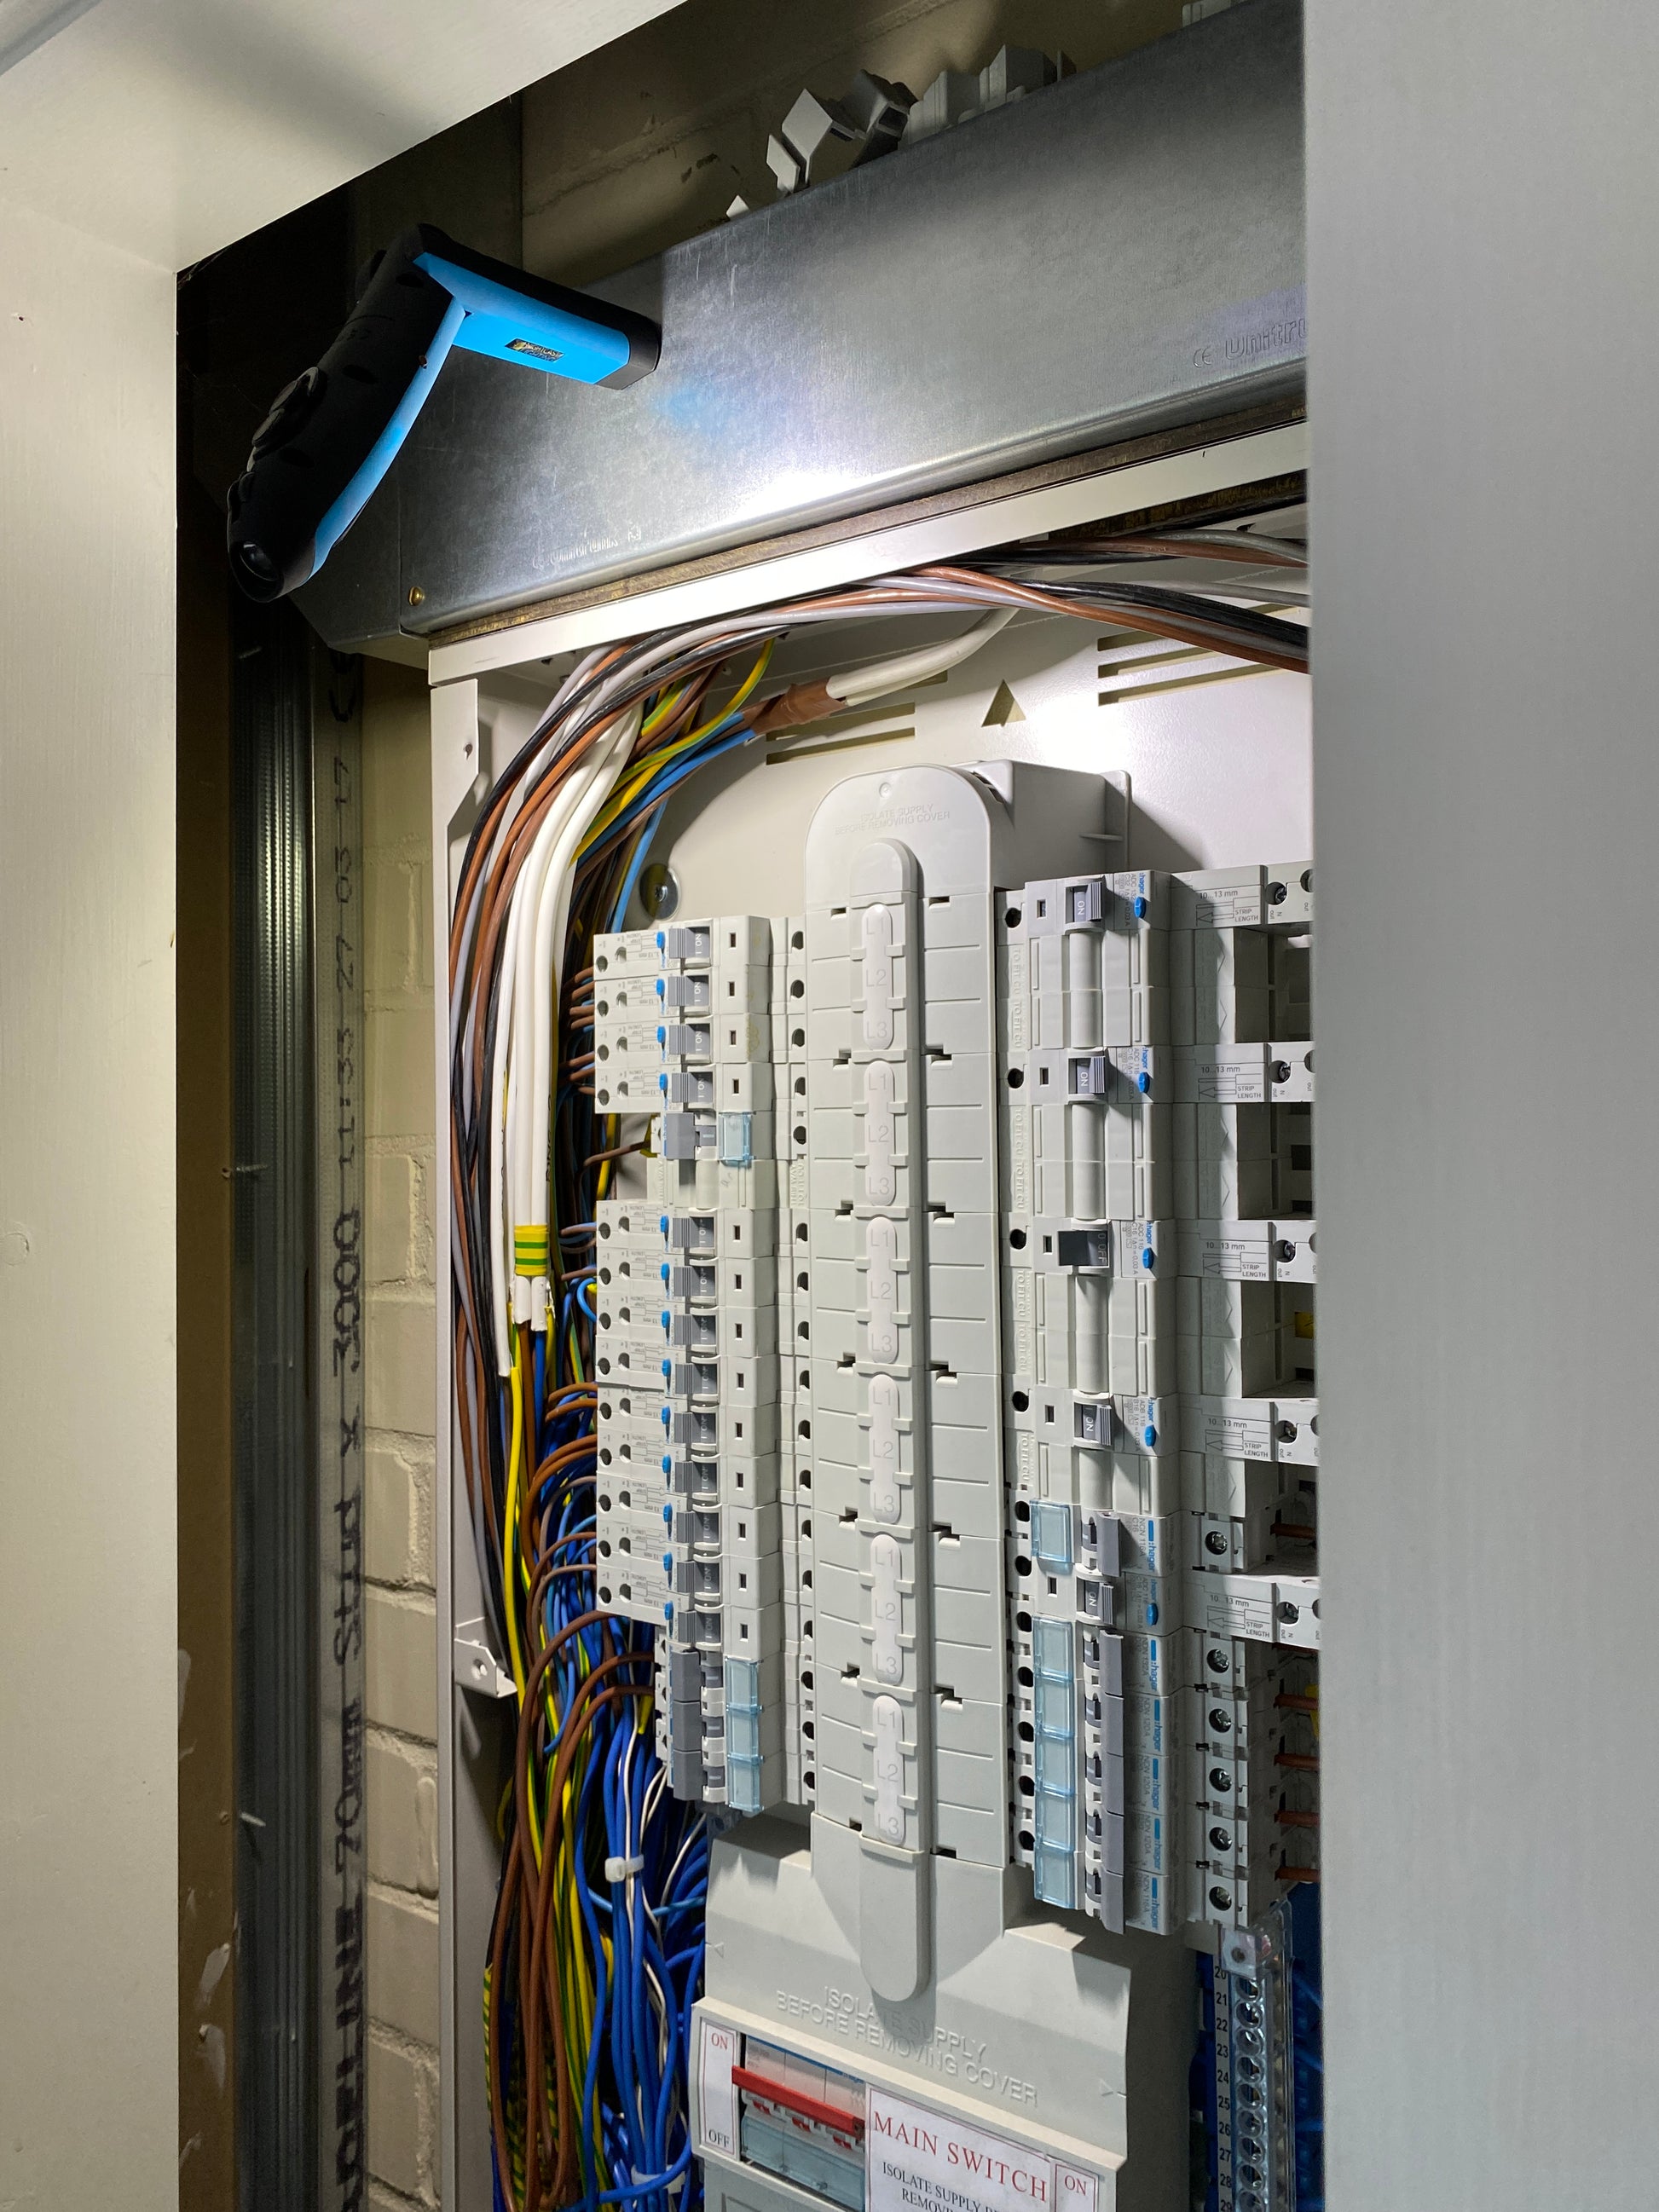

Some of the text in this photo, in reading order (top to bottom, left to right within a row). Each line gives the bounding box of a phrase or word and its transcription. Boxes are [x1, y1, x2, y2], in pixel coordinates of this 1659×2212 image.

[334, 756, 352, 806] 17
[860, 804, 934, 821] ISOLATE SUPPLY
[869, 816, 915, 829] REMOVING
[917, 811, 950, 823] COVER
[335, 846, 353, 903] 03
[1076, 900, 1084, 916] ON
[866, 917, 886, 935] L1
[696, 934, 702, 946] ON
[335, 933, 353, 990] 27
[694, 981, 701, 994] ON
[865, 969, 887, 988] L2
[696, 1031, 702, 1043] ON
[866, 1020, 887, 1039] L3
[868, 1073, 887, 1092] L1
[1079, 1071, 1088, 1087] ON
[334, 1026, 354, 1168] 11:33
[868, 1124, 889, 1143] L2
[869, 1176, 890, 1195] L3
[870, 1228, 889, 1248] L1
[1098, 1243, 1107, 1264] OFF
[333, 1207, 361, 1376] 3000
[870, 1281, 892, 1301] L2
[871, 1332, 893, 1354] L3
[872, 1386, 892, 1406] L1
[1084, 1416, 1093, 1433] ON
[1233, 1420, 1247, 1429] mm
[872, 1439, 894, 1459] L2
[1245, 1449, 1269, 1458] LENGTH
[873, 1492, 894, 1514] L3
[333, 1486, 361, 1666] Stud
[1089, 1591, 1095, 1607] ON
[1235, 1599, 1250, 1608] mm
[1246, 1629, 1270, 1637] LENGTH
[336, 1696, 363, 1875] 70mm
[1216, 1993, 1228, 2005] 21
[824, 1986, 987, 2063] ISOLATE SUPPLY
[1217, 2019, 1228, 2031] 22
[711, 2032, 729, 2051] ON
[776, 1990, 1038, 2107] BEFORE REMOVING COVER
[1217, 2045, 1228, 2058] 23
[1217, 2071, 1229, 2084] 24
[1218, 2096, 1230, 2110] 25
[708, 2128, 730, 2148] OFF
[1219, 2122, 1230, 2135] 26
[874, 2111, 1047, 2203] MAIN SWITCH
[1219, 2148, 1231, 2162] 27
[882, 2161, 980, 2212] ISOLATE SUPPLY
[1064, 2174, 1087, 2196] ON
[1220, 2174, 1232, 2187] 28
[1221, 2200, 1233, 2212] 29
